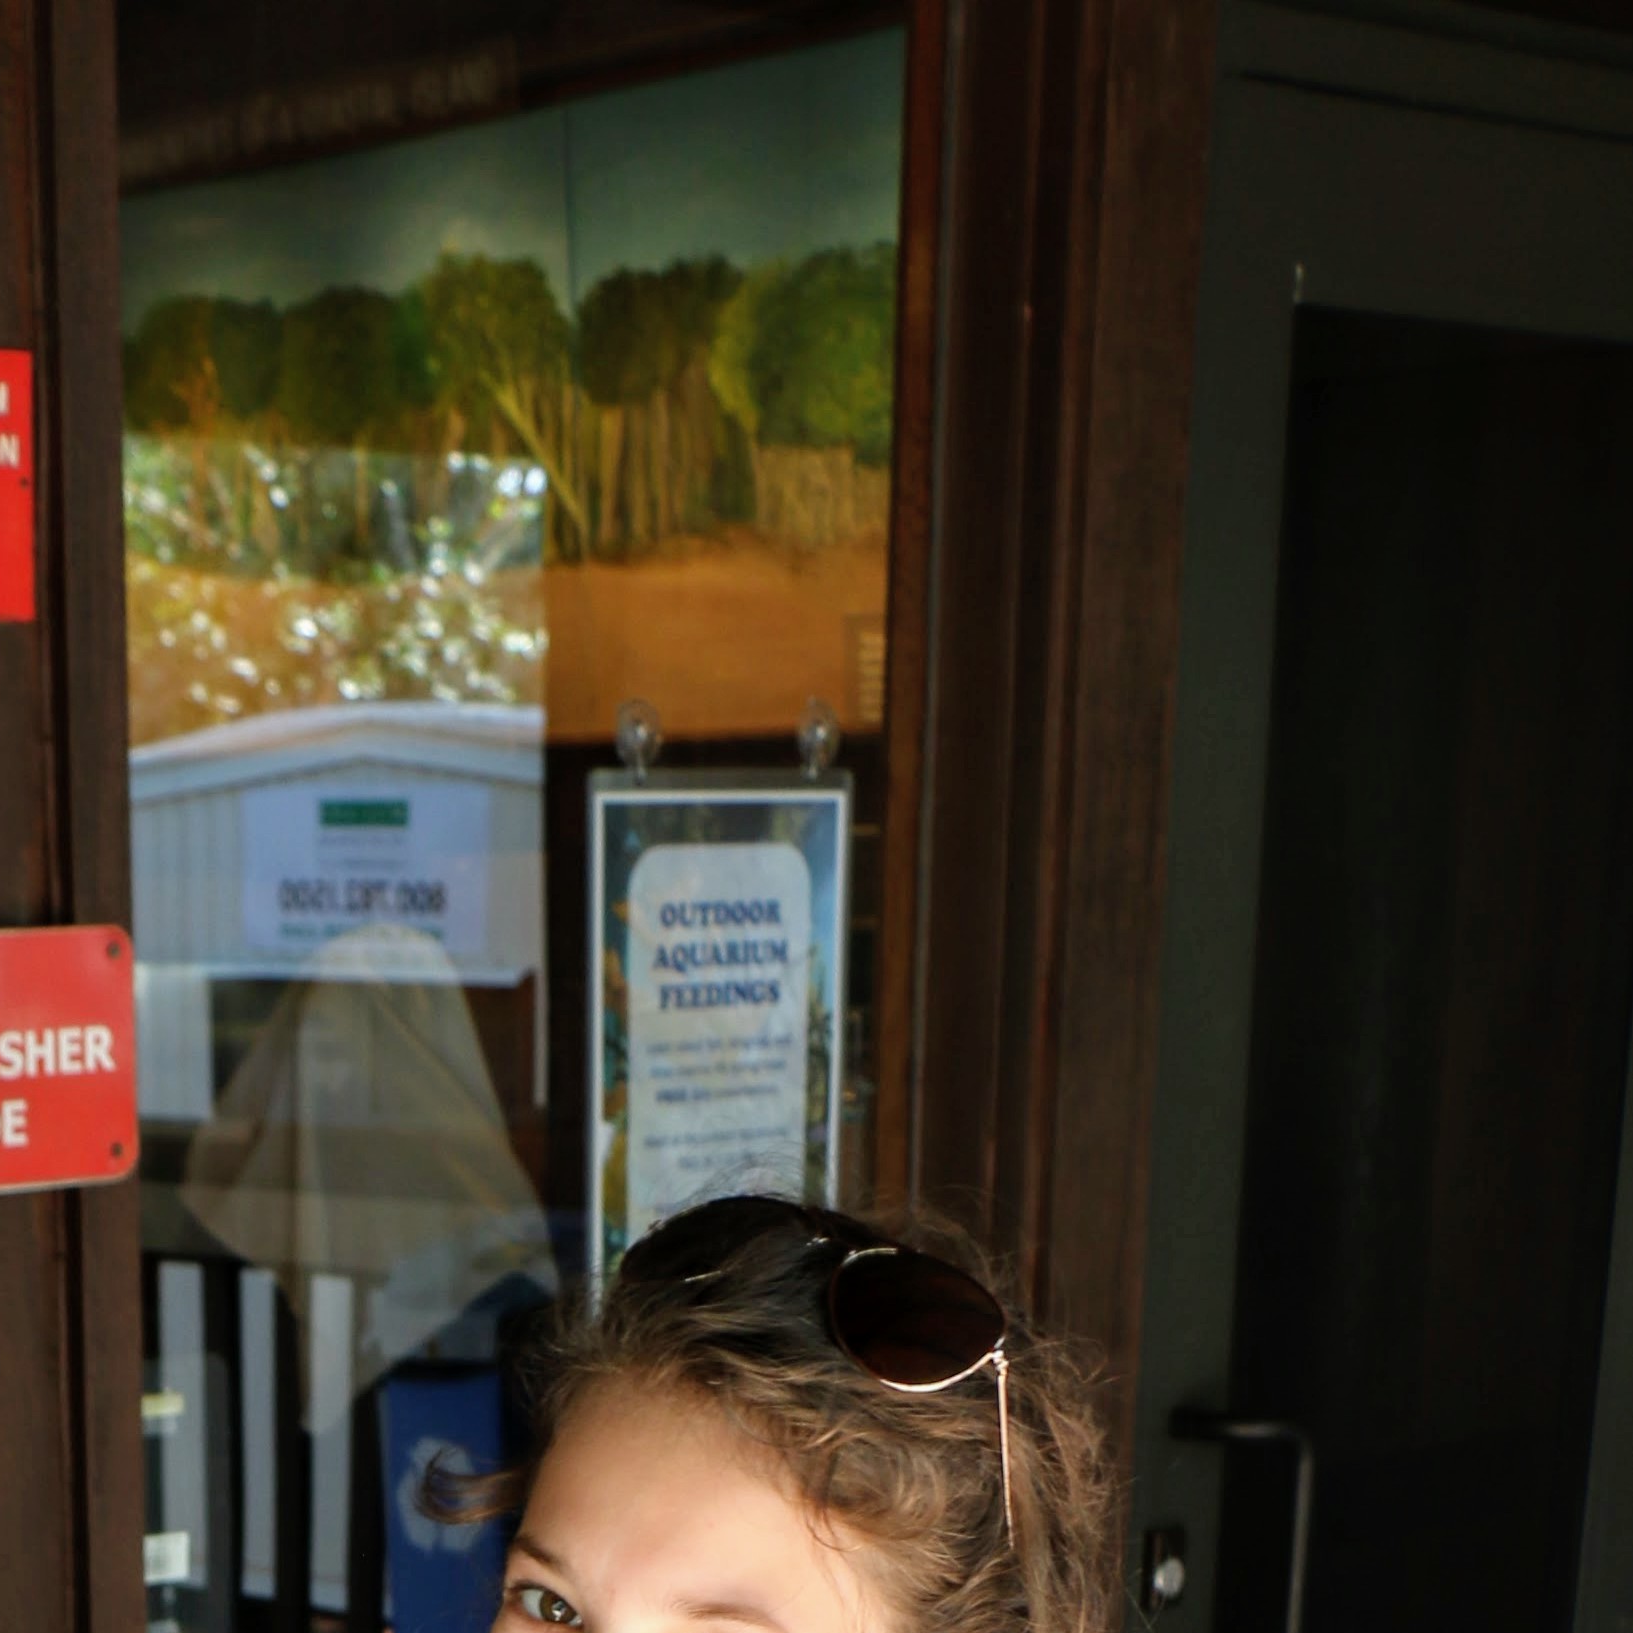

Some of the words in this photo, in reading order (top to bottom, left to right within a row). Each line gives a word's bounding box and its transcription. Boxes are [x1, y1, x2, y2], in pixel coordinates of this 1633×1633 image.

[659, 898, 782, 929] OUTDOOR
[652, 937, 788, 973] AQUARIUM
[658, 979, 780, 1011] FEEDINGS
